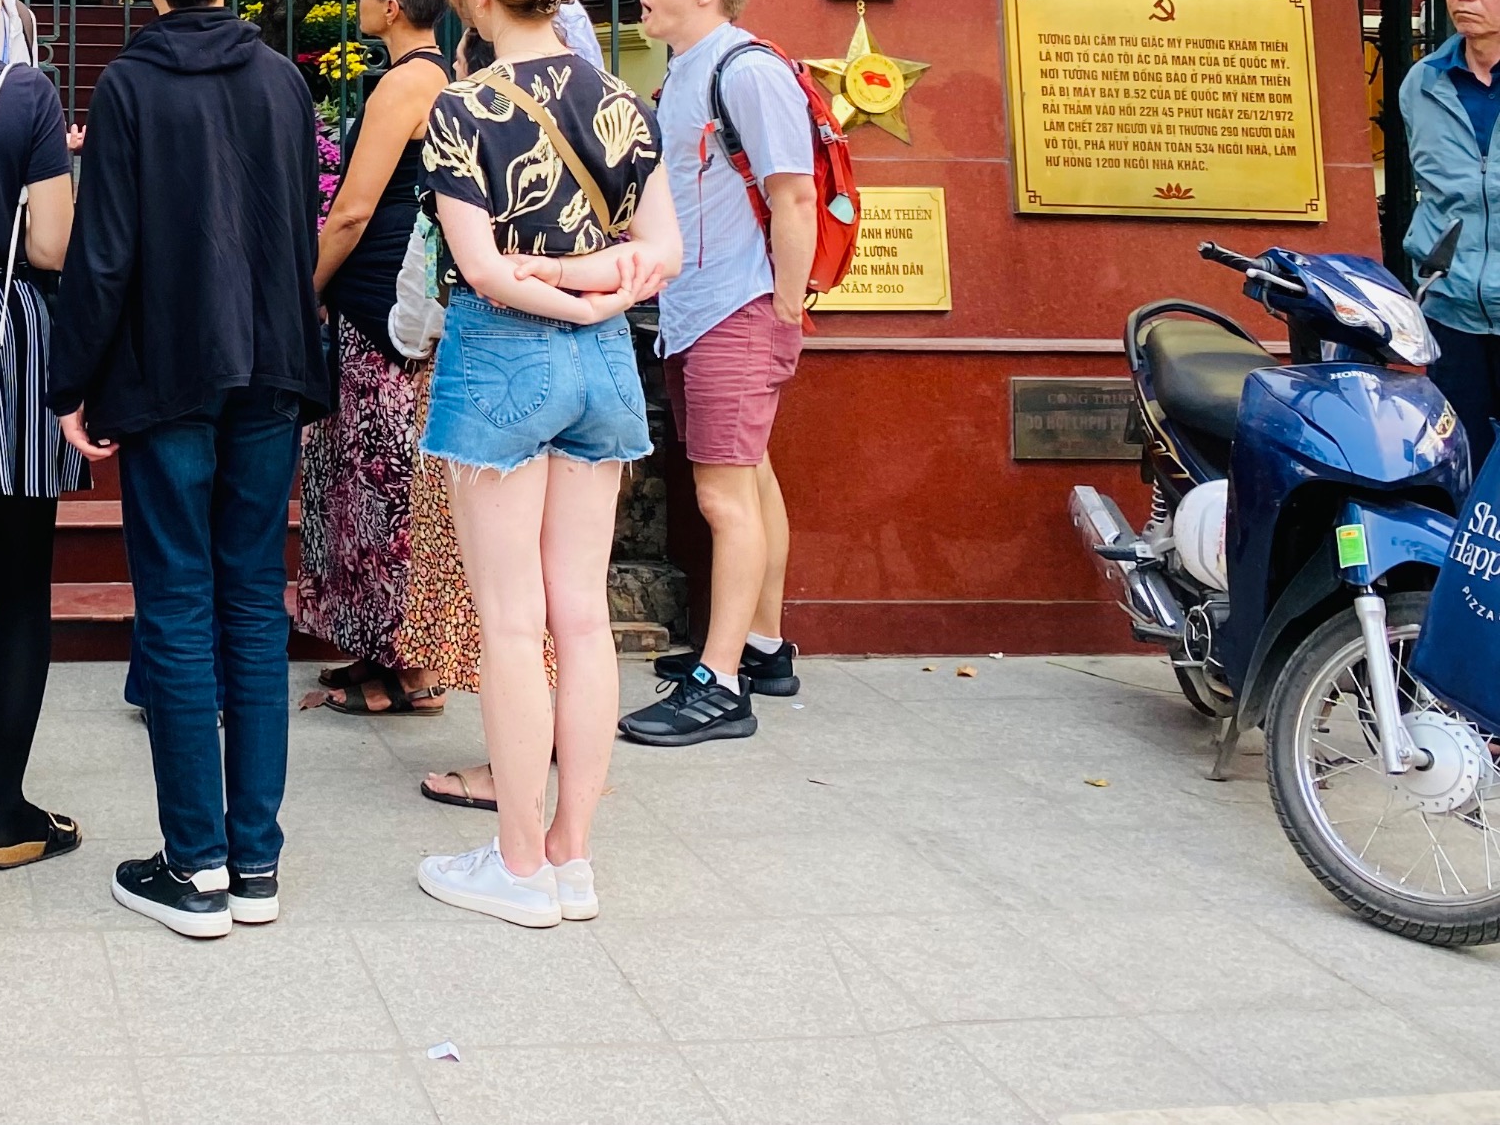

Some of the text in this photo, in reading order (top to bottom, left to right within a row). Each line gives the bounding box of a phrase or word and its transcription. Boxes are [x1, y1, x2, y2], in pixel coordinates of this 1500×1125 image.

[1172, 56, 1195, 66] MAN
[1100, 88, 1120, 98] BAY
[1269, 94, 1292, 104] BOM
[1140, 107, 1158, 117] 22H
[1162, 107, 1174, 117] 45
[1238, 110, 1293, 121] 26/12/1972
[1096, 123, 1113, 132] 287
[1221, 127, 1238, 136] 290
[1196, 143, 1214, 153] 534
[1096, 158, 1120, 168] 1200
[861, 228, 882, 239] ANH
[876, 284, 904, 293] 2010
[1329, 371, 1381, 383] HONDA
[1462, 585, 1494, 621] PIZZA
